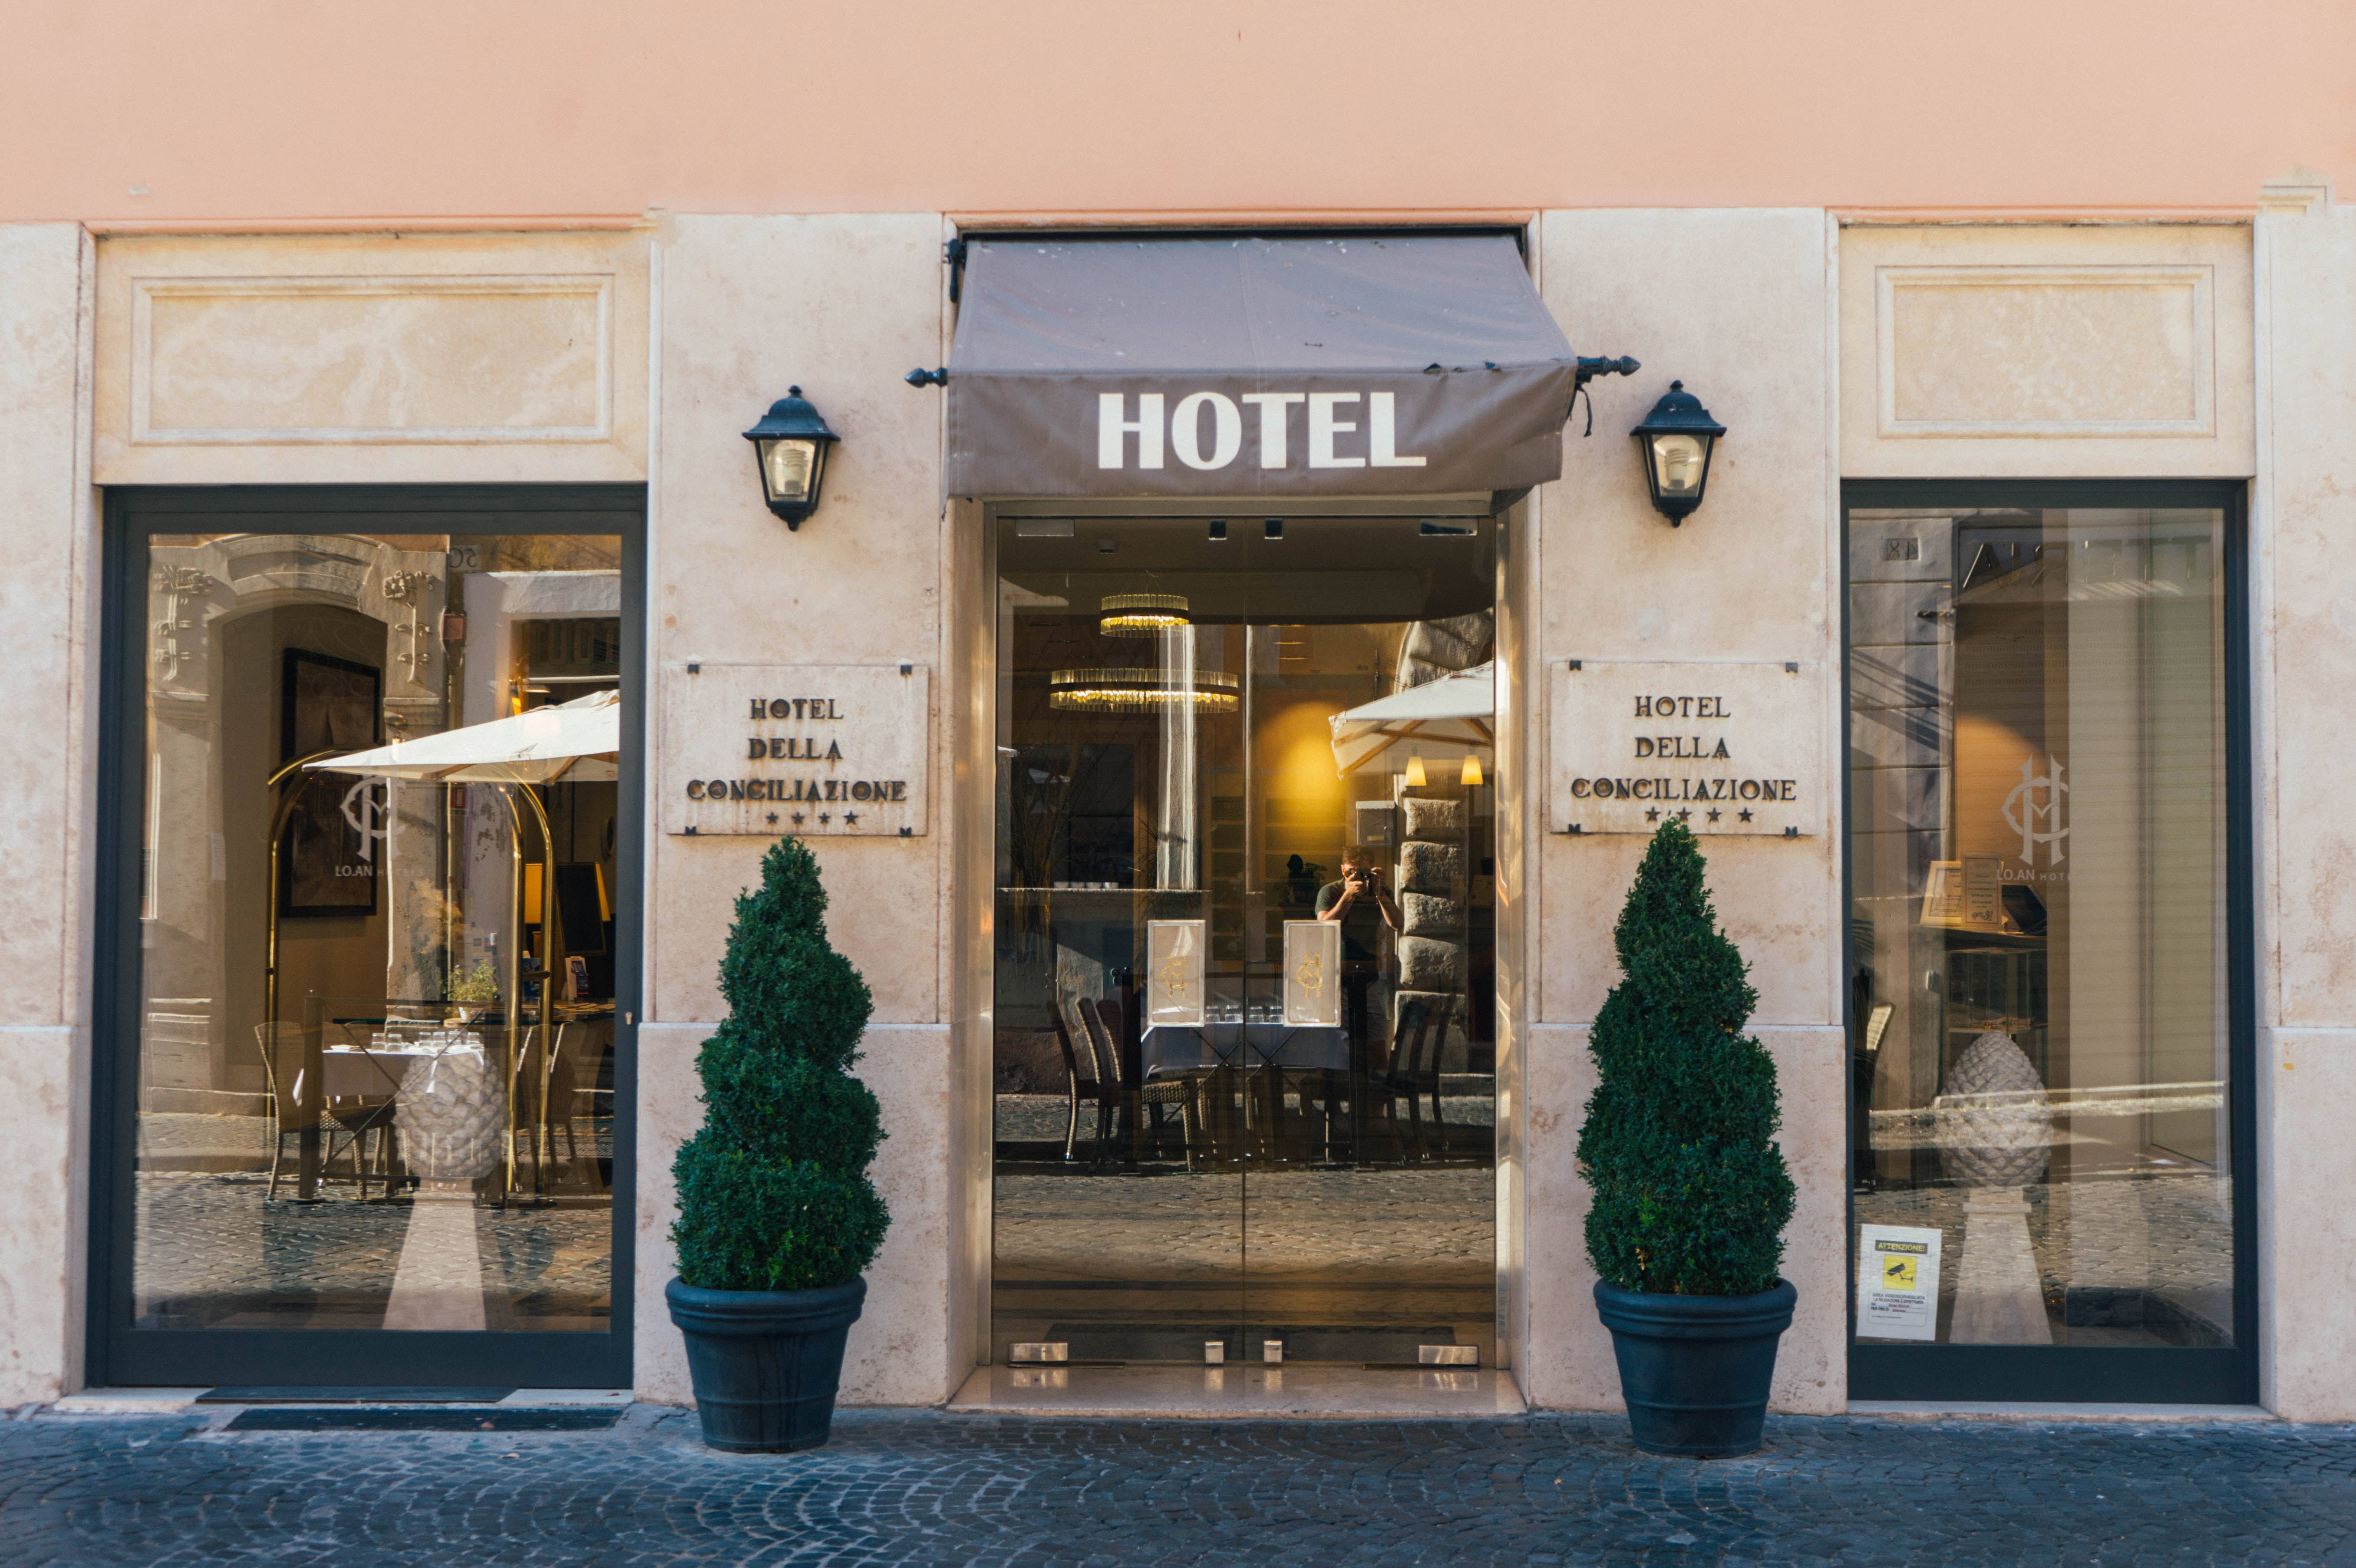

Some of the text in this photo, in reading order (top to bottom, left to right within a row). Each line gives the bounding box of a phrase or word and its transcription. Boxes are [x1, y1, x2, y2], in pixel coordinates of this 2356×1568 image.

[1098, 392, 1426, 470] HOTEL
[750, 699, 844, 720] HOTEL
[1635, 696, 1731, 717] HOTEL
[749, 738, 843, 759] DELLA
[1635, 737, 1731, 758] DELLA
[687, 779, 906, 802] CONCILIAZIONE
[1571, 778, 1796, 800] CONCILIAZIONE
[335, 865, 373, 876] LO.AN
[1997, 869, 2036, 881] LO.AN
[1878, 1242, 1925, 1251] ATTENZIONE!
